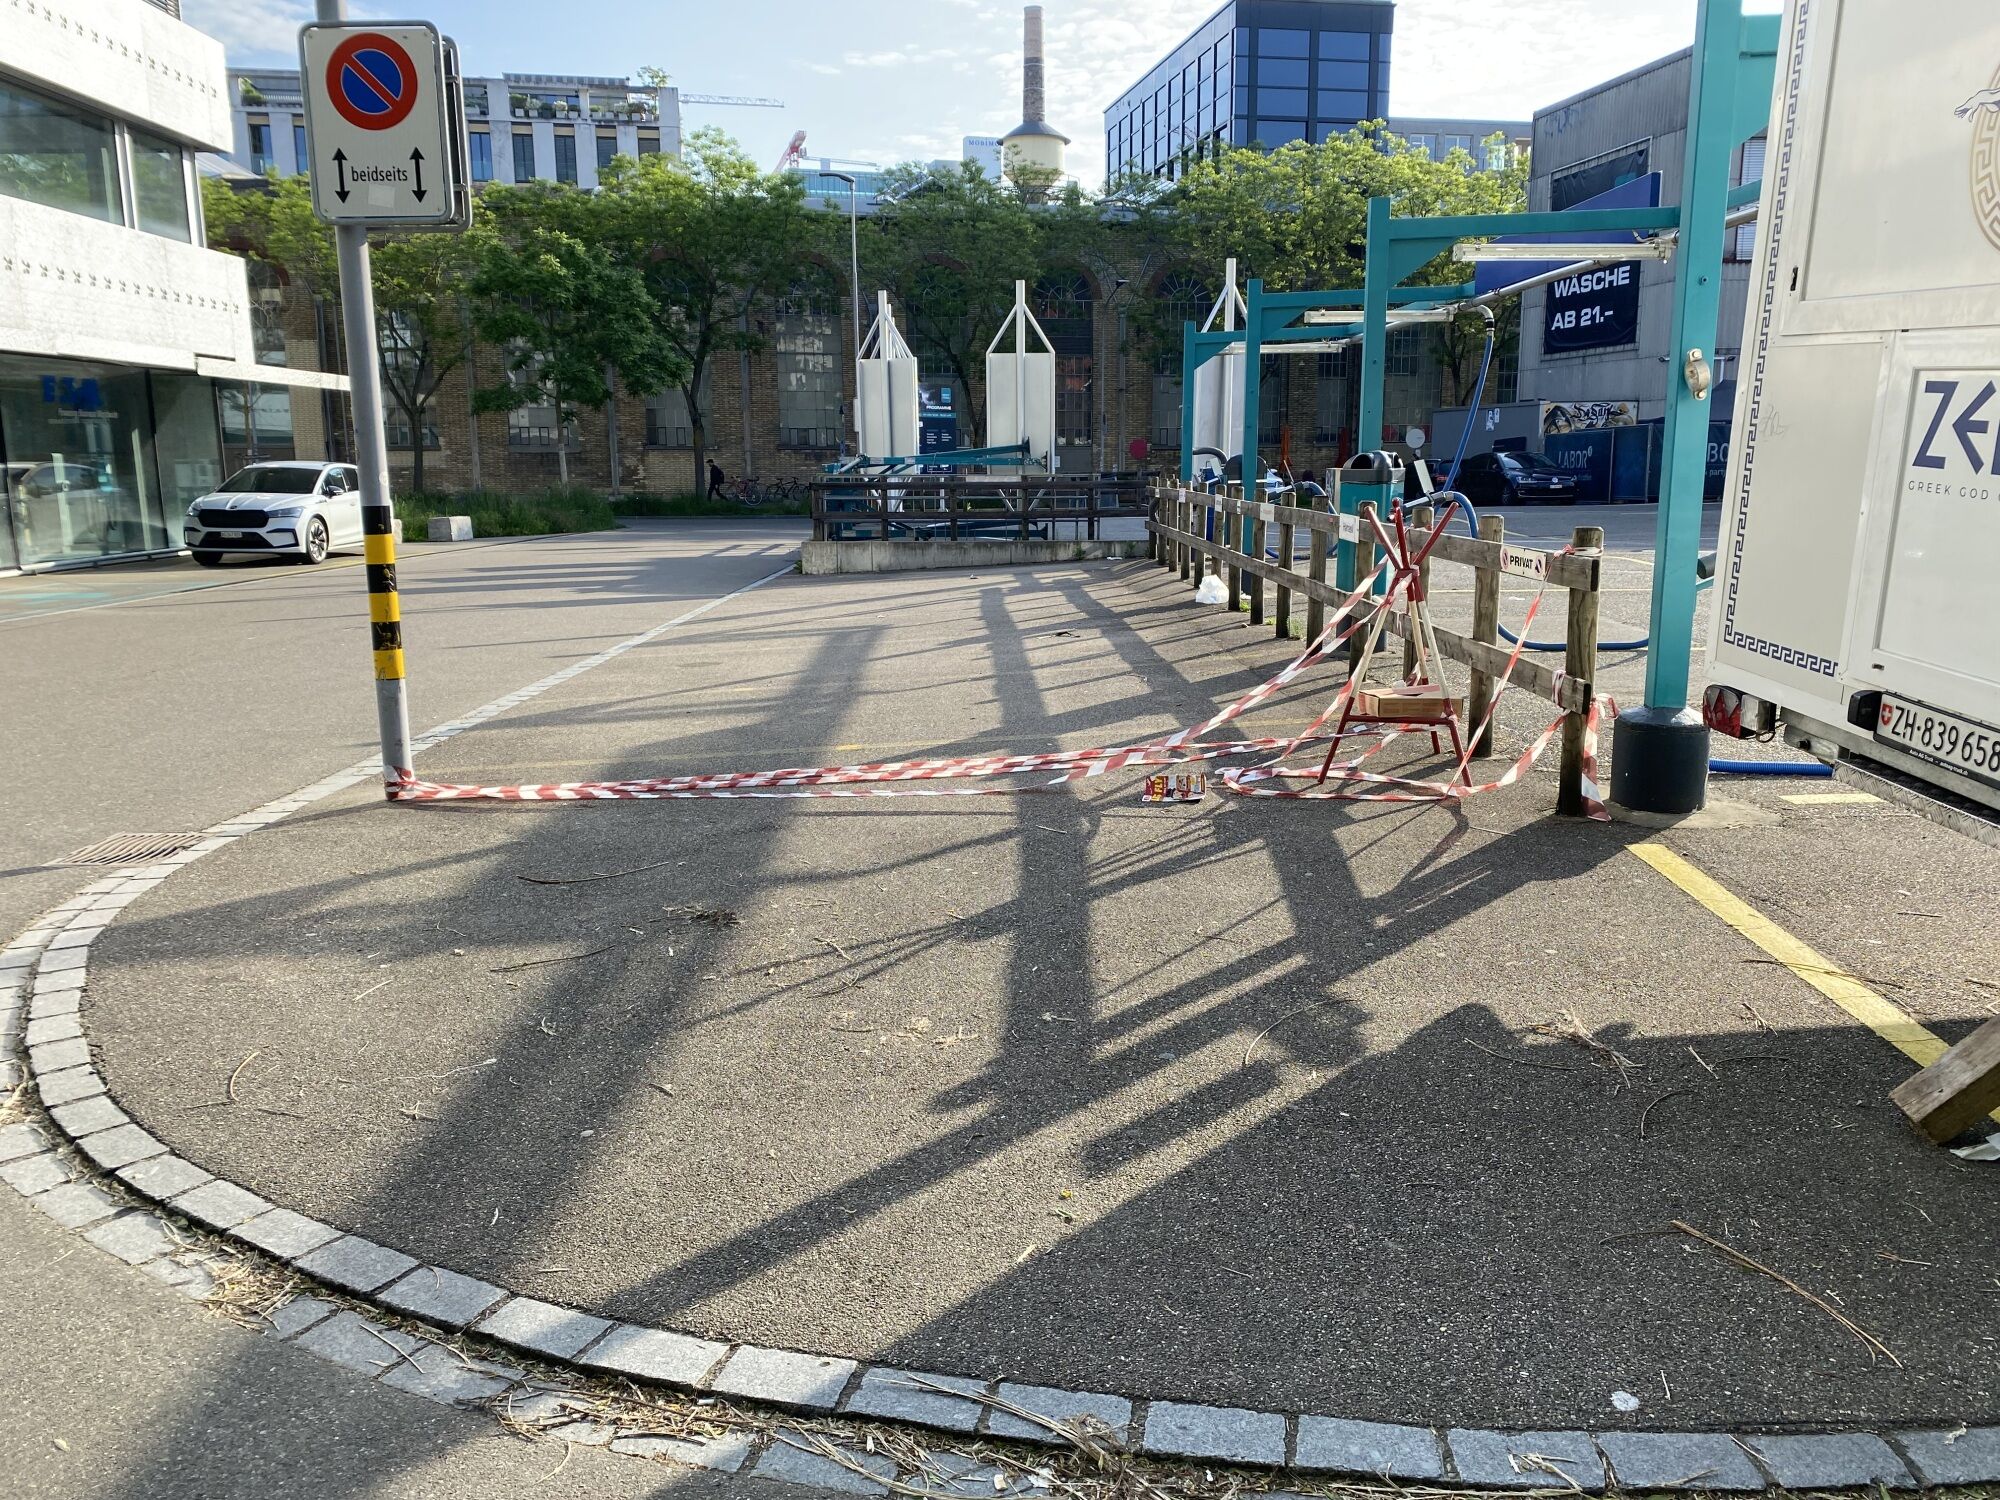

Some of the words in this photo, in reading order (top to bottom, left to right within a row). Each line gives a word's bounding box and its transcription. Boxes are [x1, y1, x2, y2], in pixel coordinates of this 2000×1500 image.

[351, 165, 408, 182] beidseits
[1554, 265, 1631, 298] WÄSCHE
[1551, 310, 1576, 330] AB
[1580, 305, 1614, 327] 21.-
[1908, 480, 1952, 496] GREEK
[1959, 487, 1989, 500] GOD
[1510, 555, 1533, 569] PRIVAT
